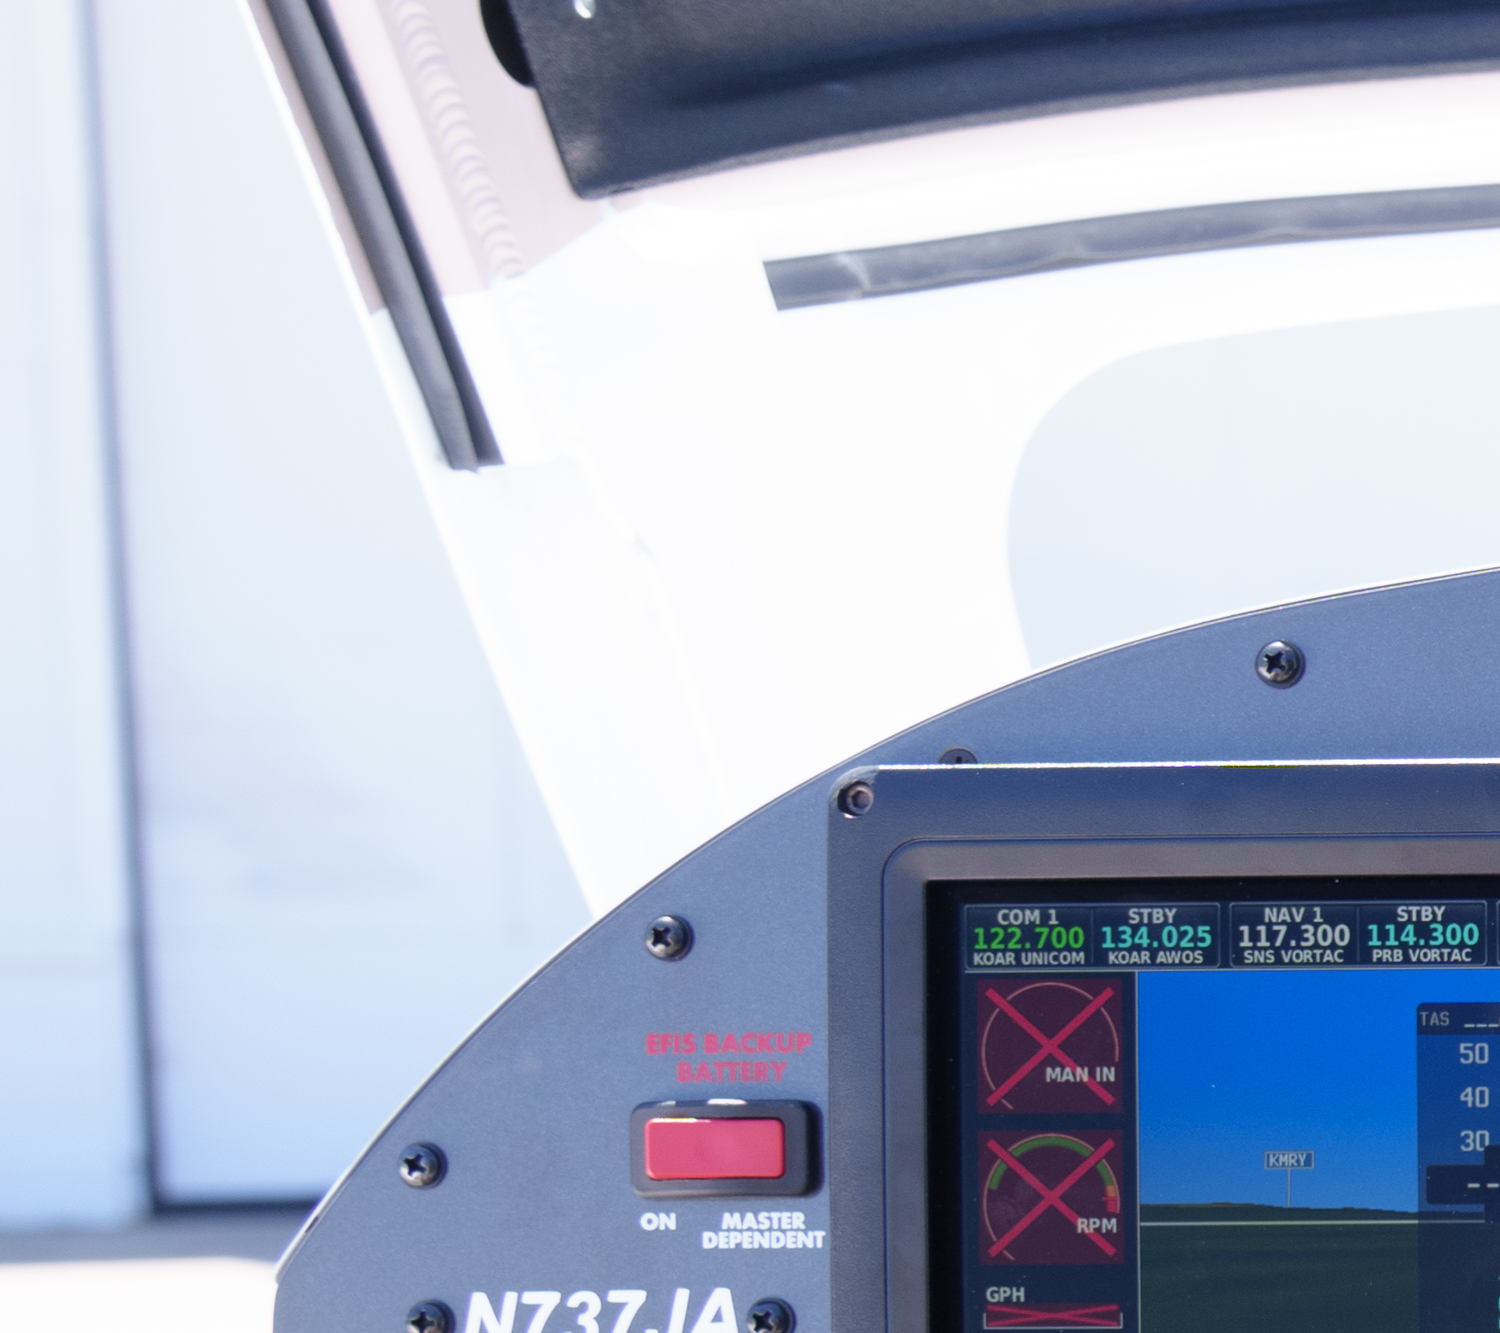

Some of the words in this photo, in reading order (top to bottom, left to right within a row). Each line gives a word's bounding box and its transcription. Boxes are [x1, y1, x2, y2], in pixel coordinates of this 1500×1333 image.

[998, 910, 1043, 924] COM
[1048, 910, 1059, 924] 1
[1129, 908, 1177, 924] STBY
[975, 927, 1084, 949] 122.700
[1102, 925, 1211, 948] 134.025
[1240, 924, 1350, 947] 117.300
[1368, 923, 1479, 946] 114.300
[973, 952, 1011, 966] KOAR
[1015, 952, 1085, 966] UNICOM
[1108, 951, 1147, 965] KOAR
[1151, 951, 1204, 965] AWOS
[647, 1033, 697, 1054] EFIS
[704, 1033, 812, 1054] BACKUP
[678, 1061, 787, 1082] BATTERY
[640, 1214, 677, 1232] ON
[1076, 1218, 1117, 1233] RPM
